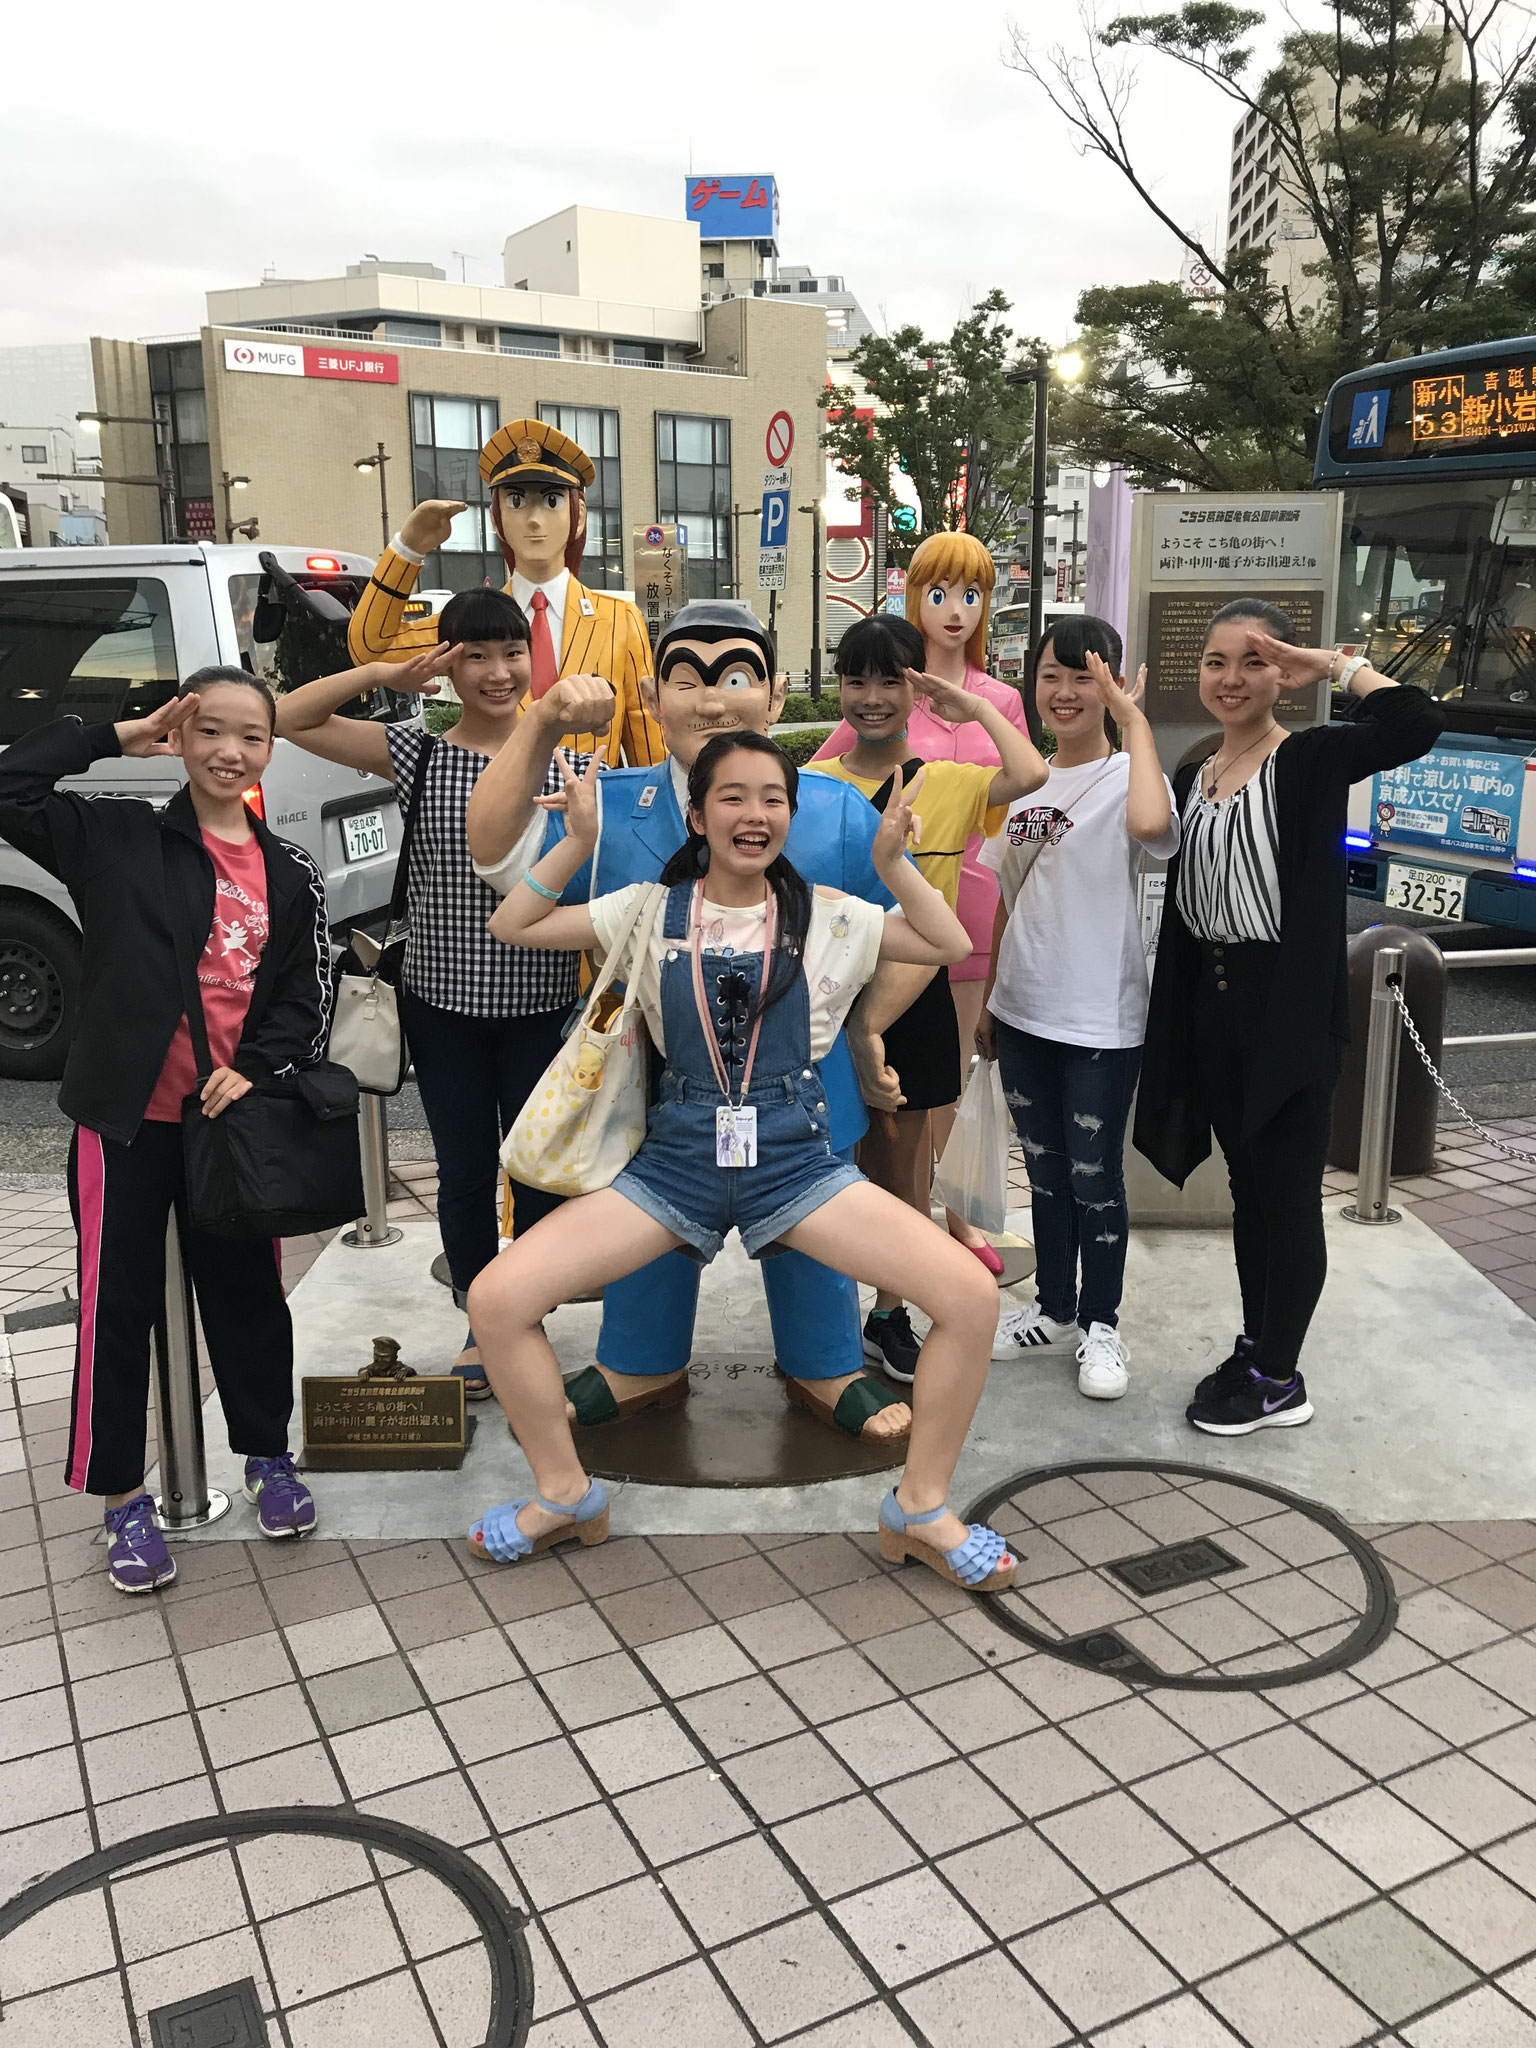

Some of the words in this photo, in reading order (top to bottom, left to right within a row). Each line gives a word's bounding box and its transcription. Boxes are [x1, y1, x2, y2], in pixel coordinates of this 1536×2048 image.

[691, 180, 768, 210] ゲーム
[258, 352, 296, 366] MUFG
[318, 357, 385, 374] 三菱UFJ銀行
[1484, 367, 1536, 391] 青砥
[1416, 380, 1461, 408] 新小
[1463, 389, 1536, 426] 新小岩
[1419, 412, 1457, 435] 53
[767, 497, 784, 542] P
[1160, 537, 1204, 549] ようこそ
[1379, 766, 1515, 798] 便利で涼しい車内の
[276, 811, 308, 826] HIACE
[1027, 808, 1054, 822] VANS
[1025, 822, 1045, 839] THE
[1408, 869, 1445, 885] 足立200
